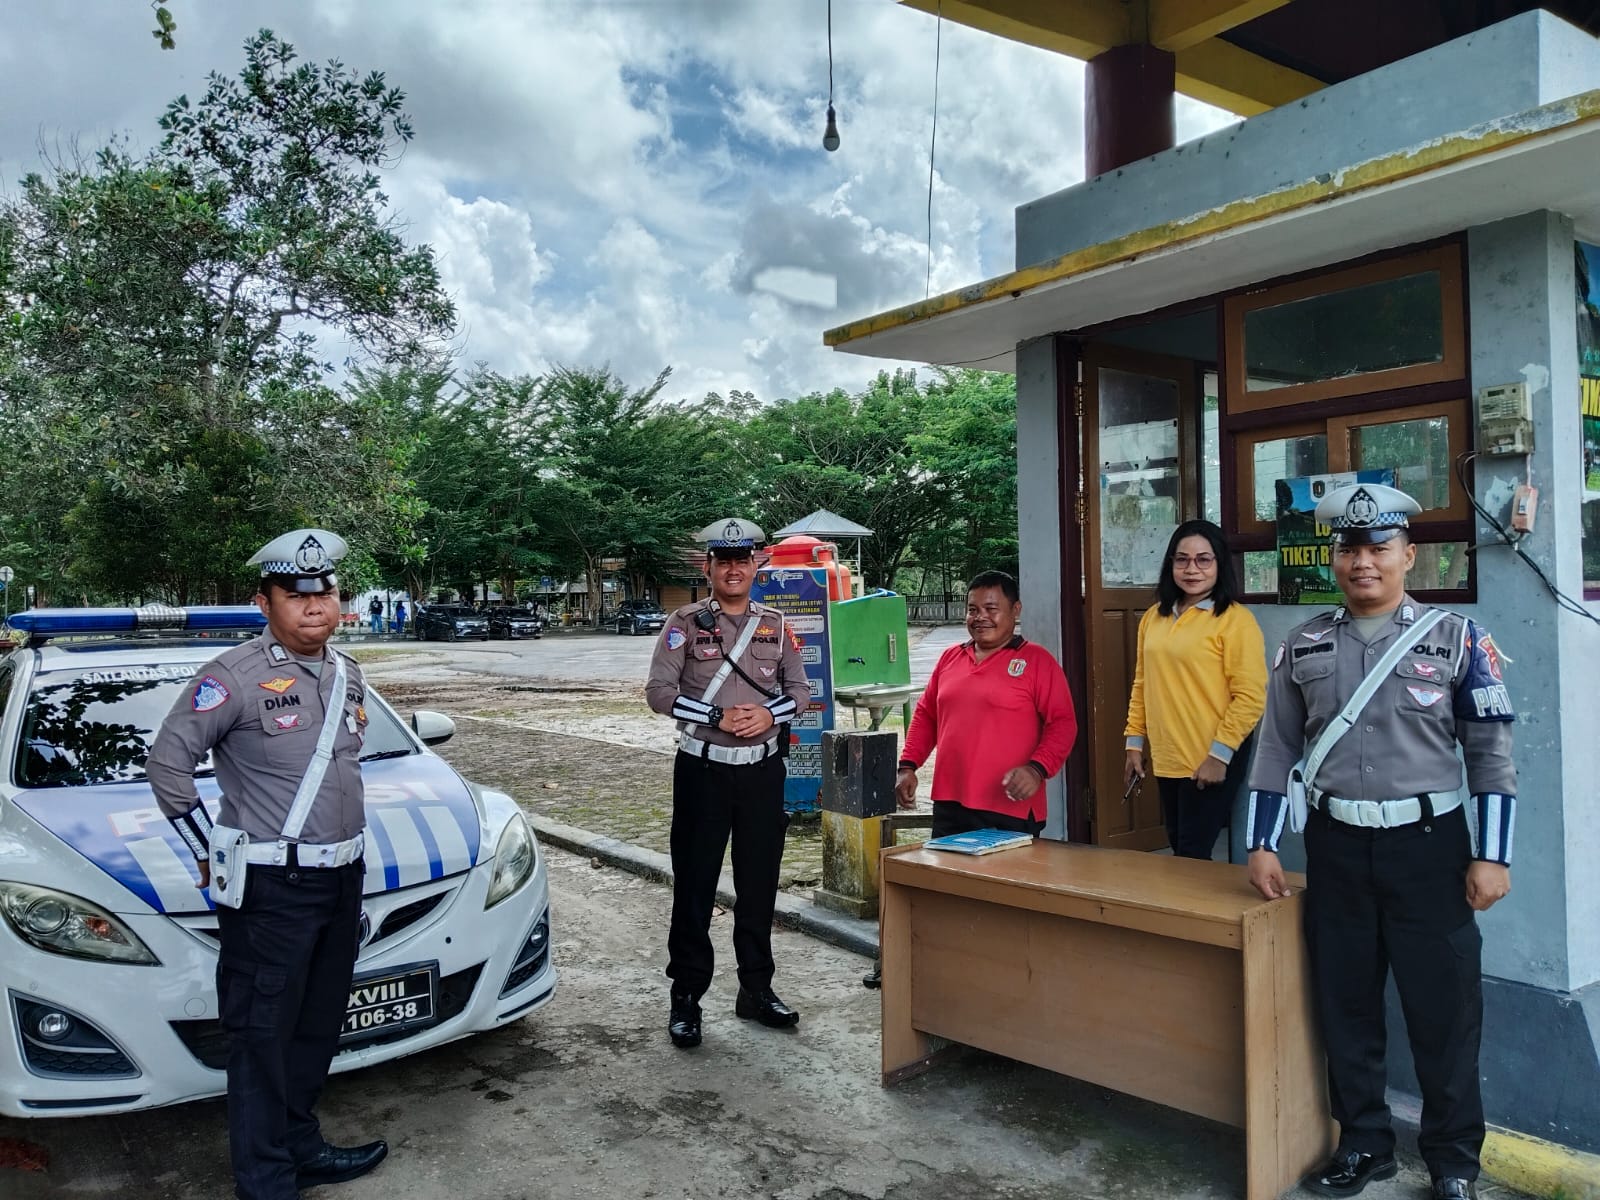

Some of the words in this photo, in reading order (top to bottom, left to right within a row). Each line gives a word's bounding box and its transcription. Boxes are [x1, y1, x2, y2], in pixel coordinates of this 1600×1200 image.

[1281, 546, 1317, 566] TIKET
[752, 636, 779, 645] POLRI
[1410, 644, 1451, 659] OLRI
[82, 667, 170, 684] SATLANTAS
[264, 695, 301, 710] DIAN
[1472, 685, 1513, 717] PAT
[347, 981, 405, 1008] XVIII
[341, 1002, 418, 1032] 106-38
